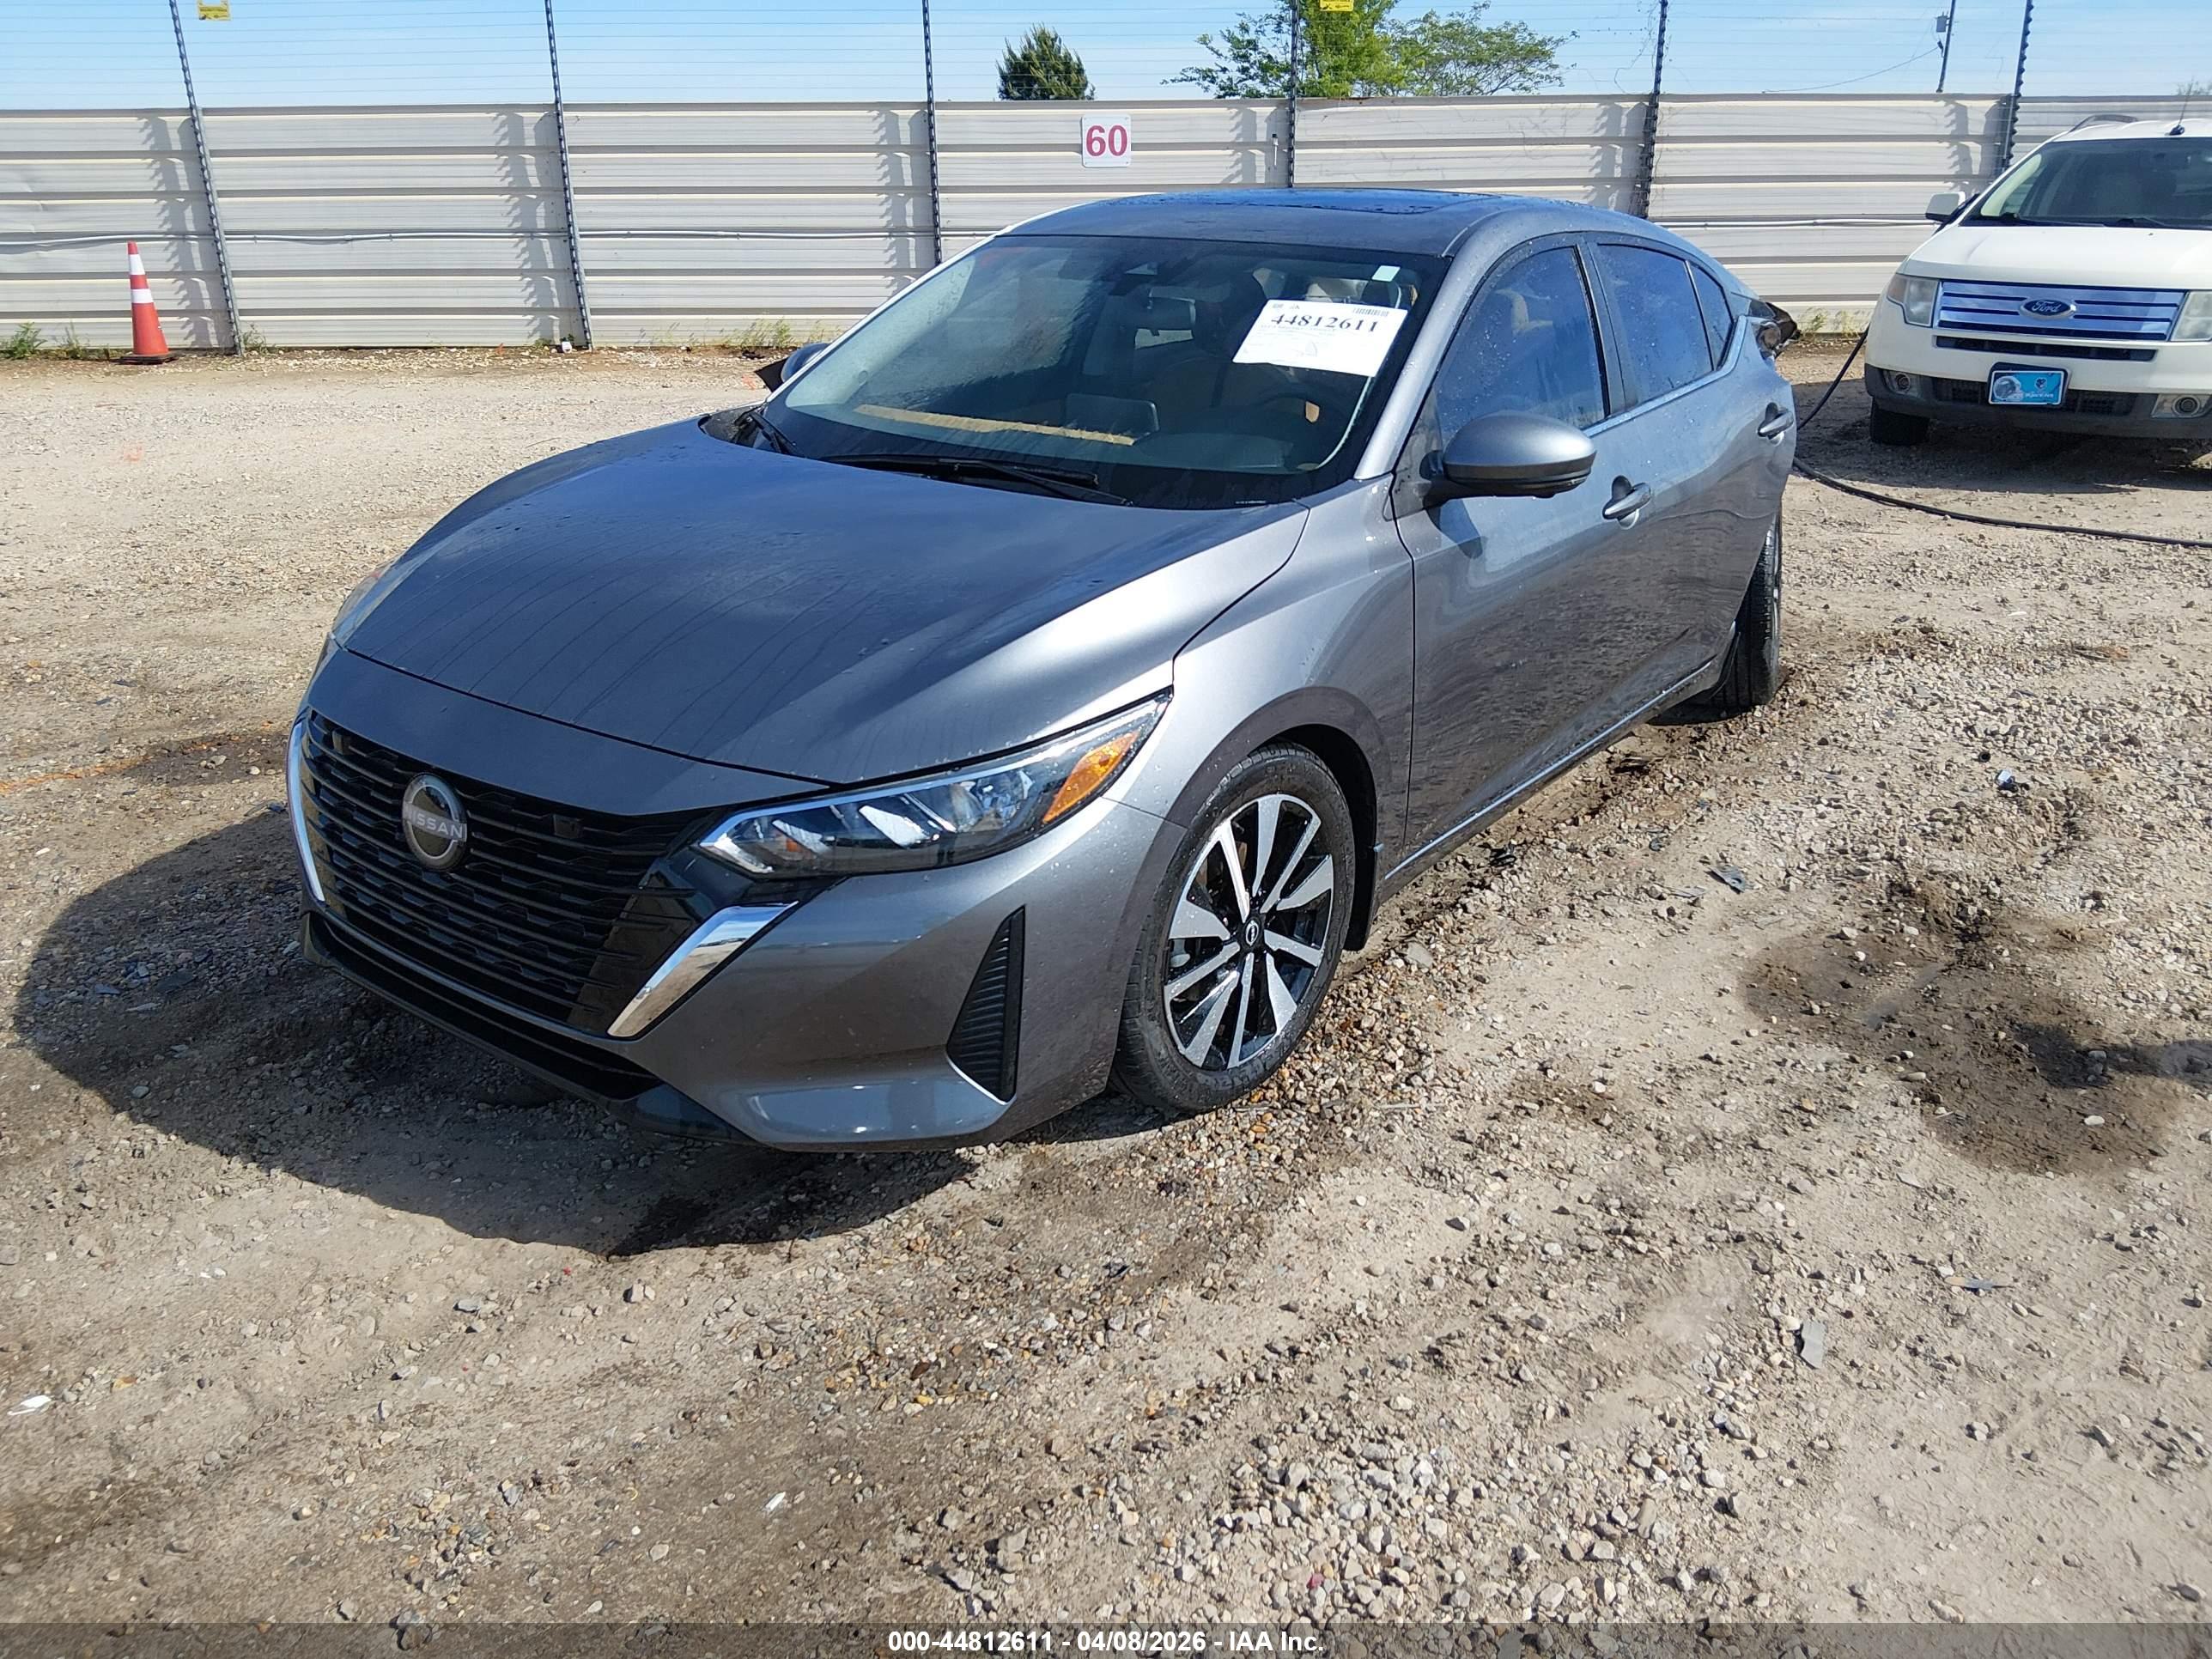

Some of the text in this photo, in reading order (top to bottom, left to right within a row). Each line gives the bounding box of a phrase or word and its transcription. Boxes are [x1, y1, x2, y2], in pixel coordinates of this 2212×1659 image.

[1085, 125, 1127, 157] 60
[2031, 301, 2062, 313] Ford
[1271, 313, 1378, 332] 44812611
